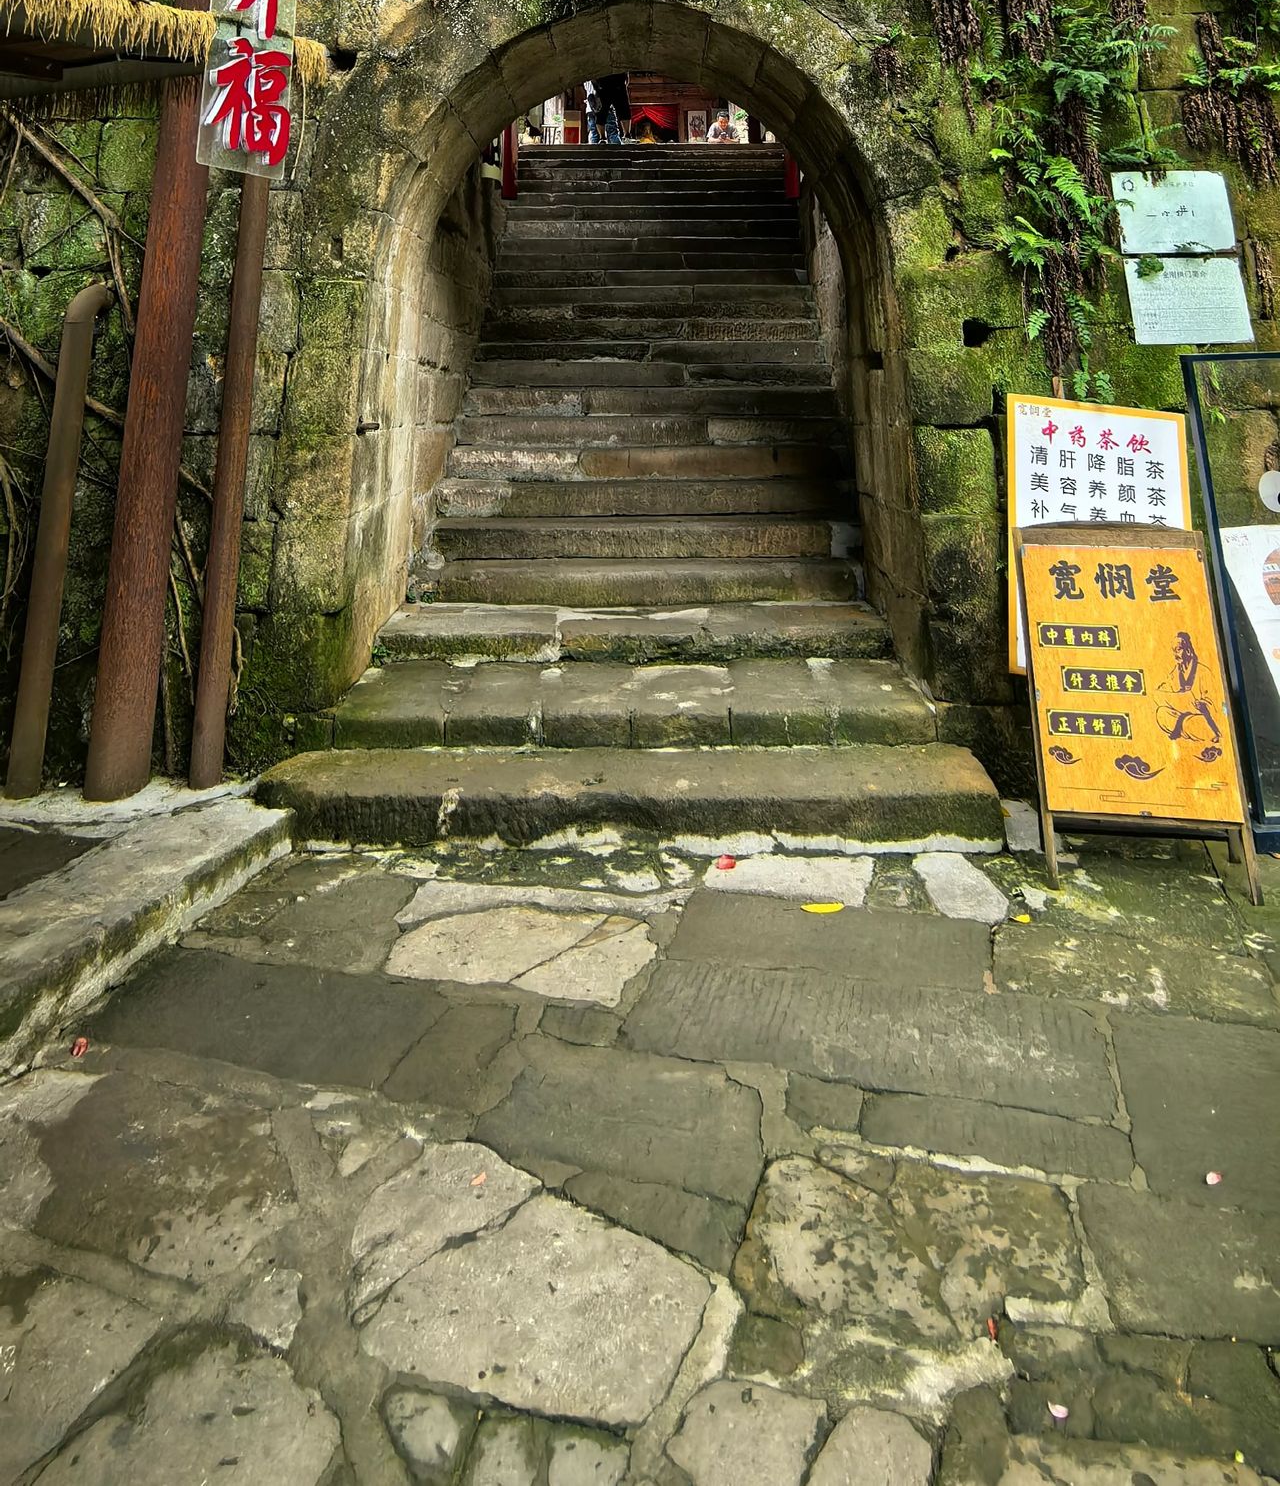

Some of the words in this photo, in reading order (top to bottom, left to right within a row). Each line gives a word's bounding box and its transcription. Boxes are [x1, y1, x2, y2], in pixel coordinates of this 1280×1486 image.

[1041, 419, 1152, 454] 中药茶饮
[1030, 445, 1165, 480] 清肝降脂茶
[1030, 472, 1167, 507] 美容养颜茶
[1048, 560, 1182, 602] 宽悯堂
[1070, 672, 1138, 692] 針灸推拿
[1058, 716, 1122, 736] 正骨舒筋
